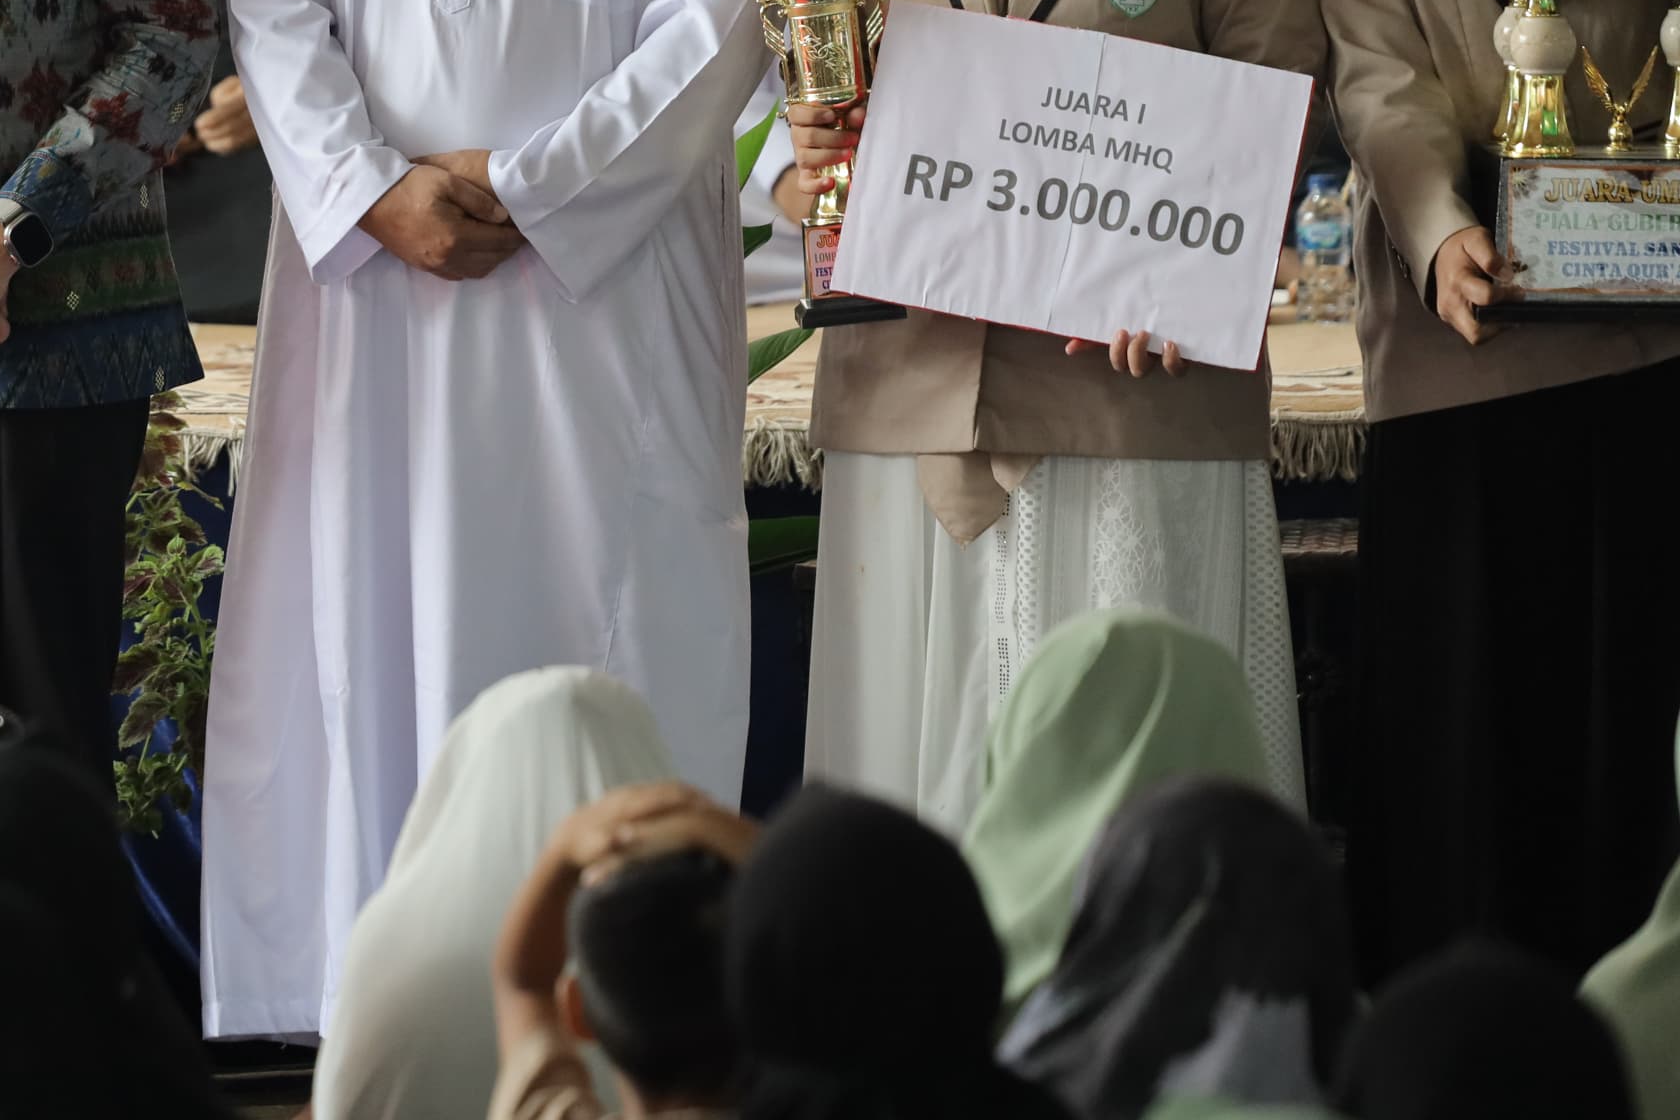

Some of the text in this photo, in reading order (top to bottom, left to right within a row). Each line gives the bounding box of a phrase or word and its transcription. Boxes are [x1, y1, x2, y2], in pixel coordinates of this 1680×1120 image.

[1040, 86, 1147, 125] JUARA I
[998, 118, 1173, 175] LOMBA MHQ
[1544, 176, 1634, 204] JUARA
[904, 153, 1245, 256] RP 3.000.000
[1535, 211, 1599, 230] PIALA
[1546, 240, 1640, 257] FESTIVAL
[1561, 262, 1622, 279] CINTA
